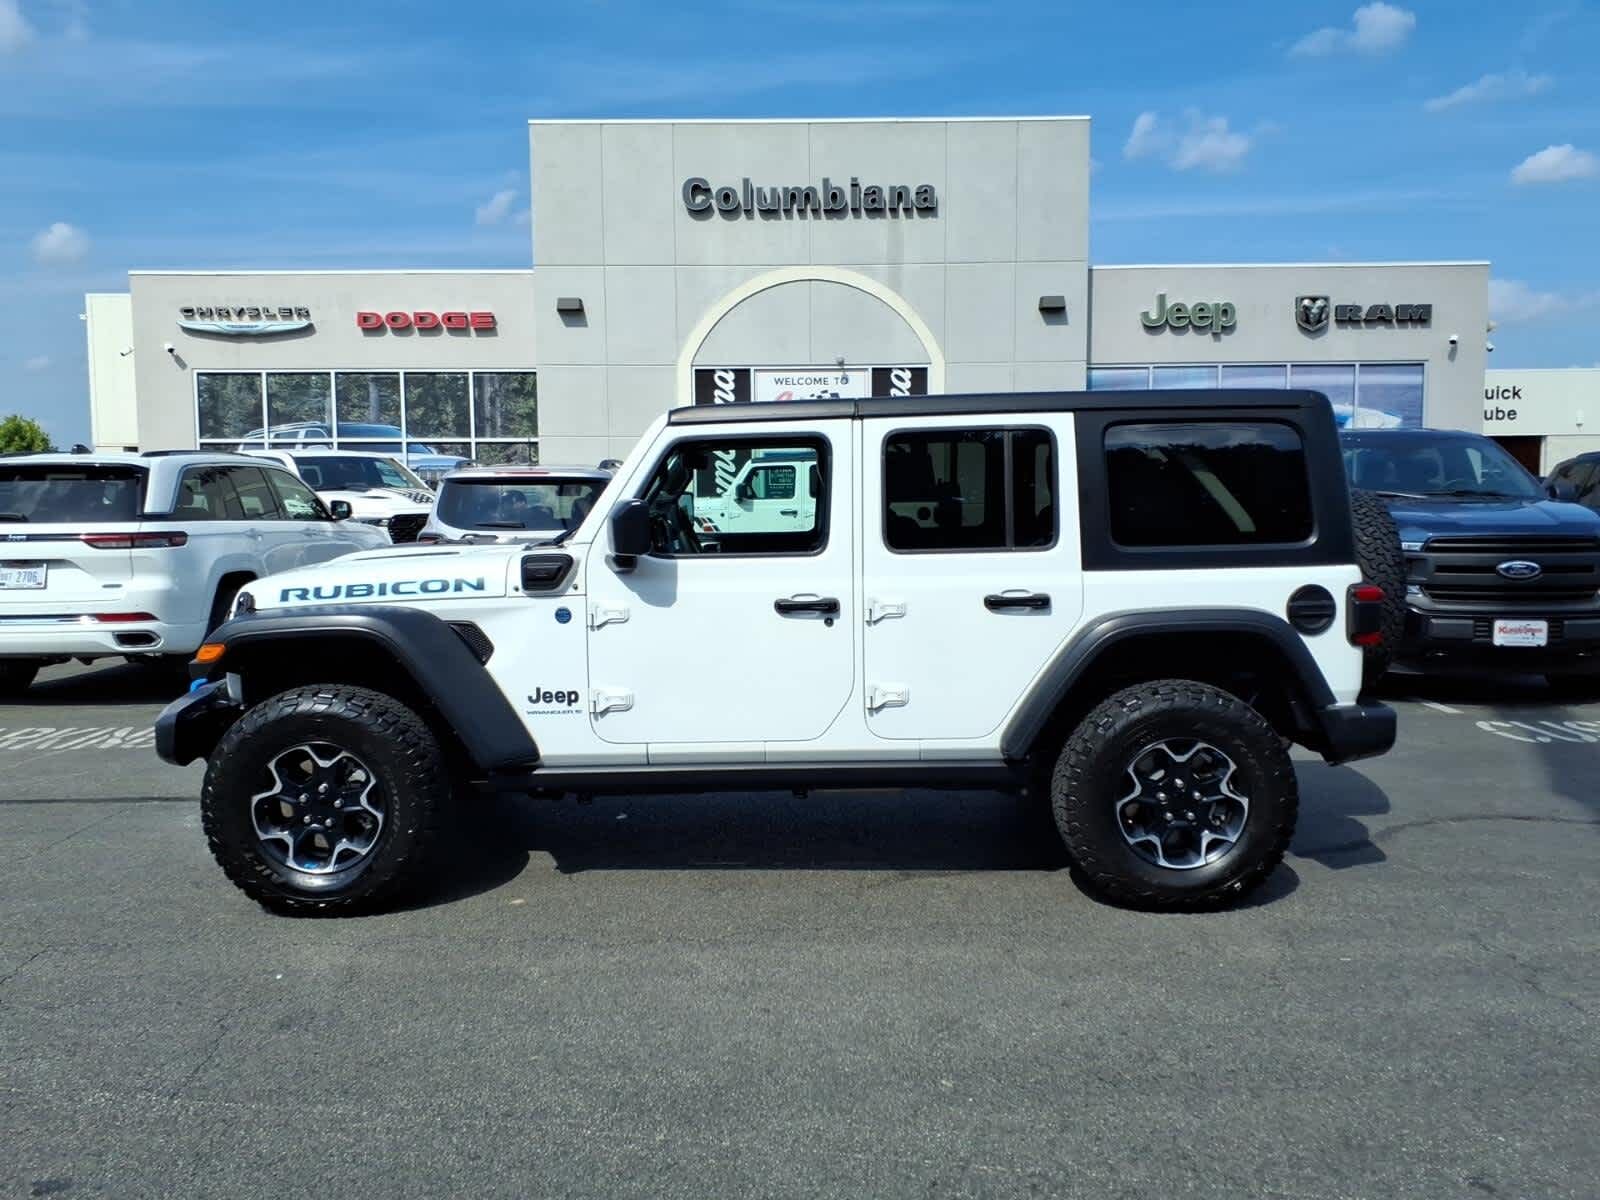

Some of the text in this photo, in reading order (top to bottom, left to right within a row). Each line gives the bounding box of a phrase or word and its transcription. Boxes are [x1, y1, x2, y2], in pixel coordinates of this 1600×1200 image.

[682, 177, 938, 213] Columbiana
[179, 306, 311, 319] CHRYSLER
[357, 312, 498, 330] DODGE
[1141, 293, 1236, 333] Jeep
[1335, 304, 1432, 323] RAM
[774, 375, 849, 386] WELCOME TO
[1484, 385, 1522, 400] uick
[1484, 405, 1517, 421] ube
[280, 577, 485, 602] RUBICON
[527, 686, 580, 707] Jeep
